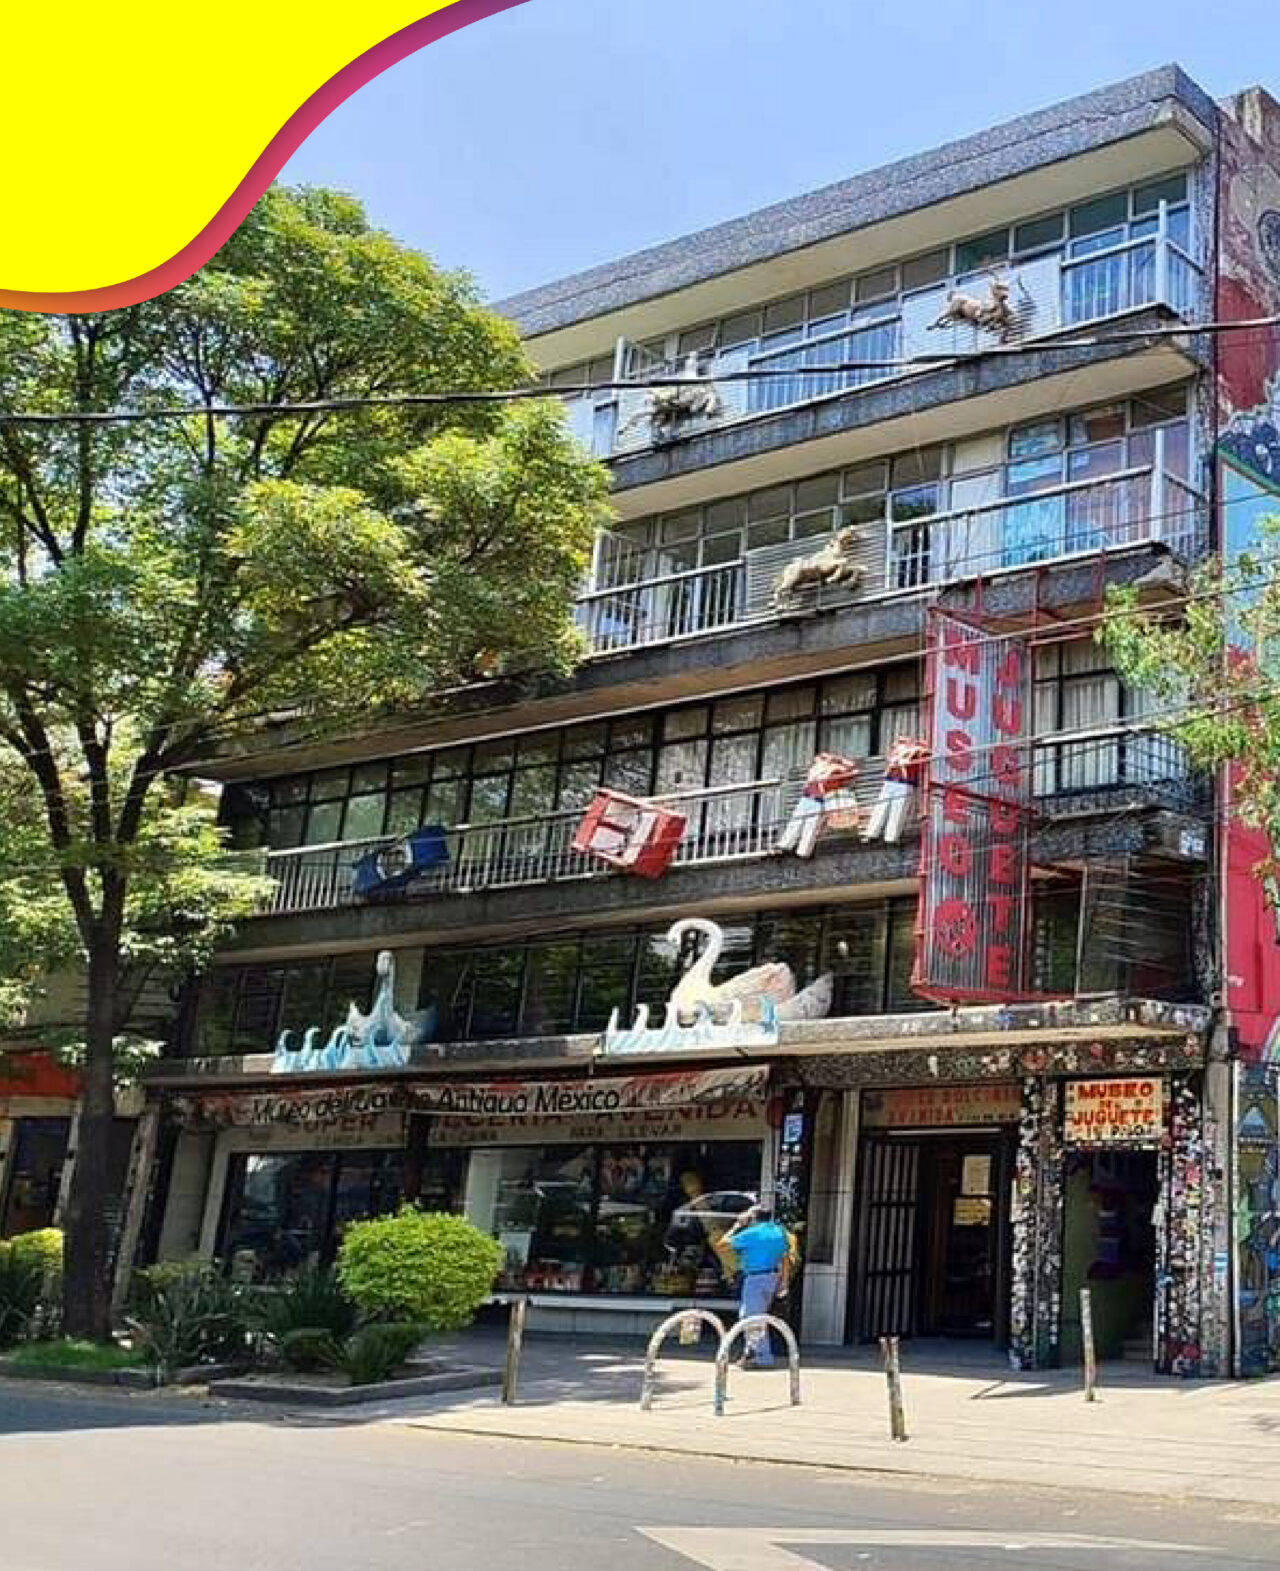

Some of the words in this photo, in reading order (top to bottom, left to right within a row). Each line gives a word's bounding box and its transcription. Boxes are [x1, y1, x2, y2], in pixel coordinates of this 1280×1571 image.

[940, 624, 982, 880] MUSEO
[986, 648, 1023, 989] JUGUETE
[251, 1097, 315, 1125] Museo
[440, 1087, 528, 1116] Antiguo
[1077, 1082, 1153, 1100] MUSEO
[1072, 1109, 1154, 1126] JUGUETE
